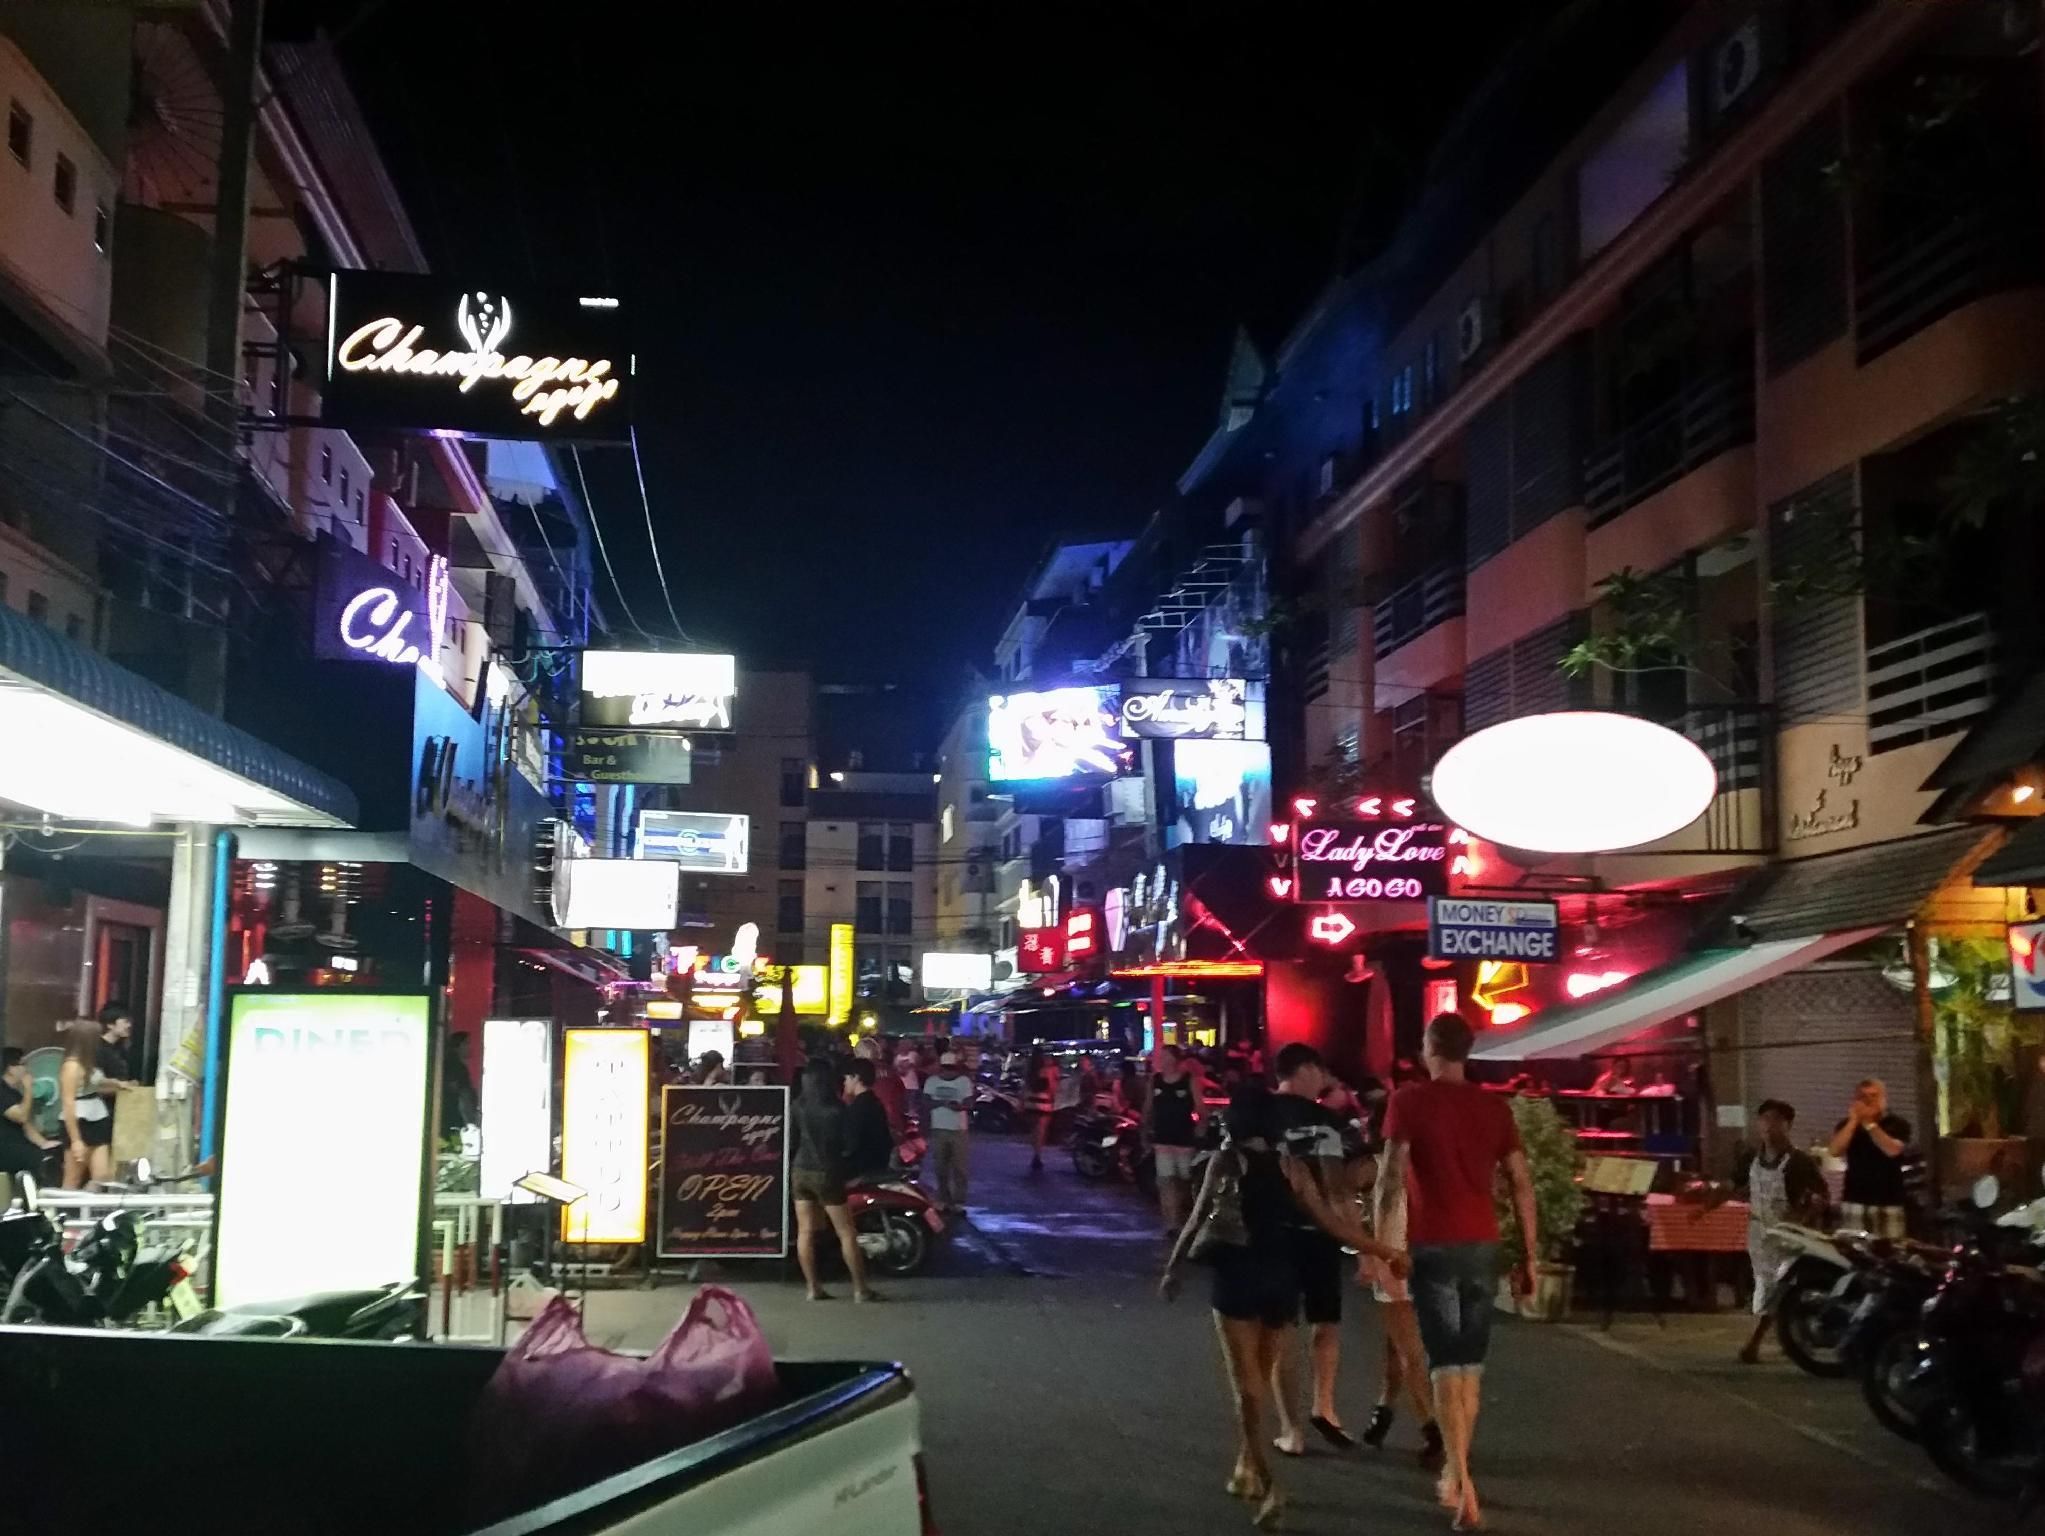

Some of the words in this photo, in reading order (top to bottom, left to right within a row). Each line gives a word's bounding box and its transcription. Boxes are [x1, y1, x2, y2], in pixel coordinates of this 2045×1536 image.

[338, 316, 612, 401] Champagne
[582, 754, 605, 765] Bar
[606, 754, 617, 766] &
[1301, 829, 1376, 872] Lady
[1374, 828, 1446, 862] Love
[1442, 905, 1505, 923] MONEY
[1440, 929, 1555, 957] EXCHANGE
[671, 1104, 783, 1133] Champagne
[676, 1173, 776, 1202] OPEN
